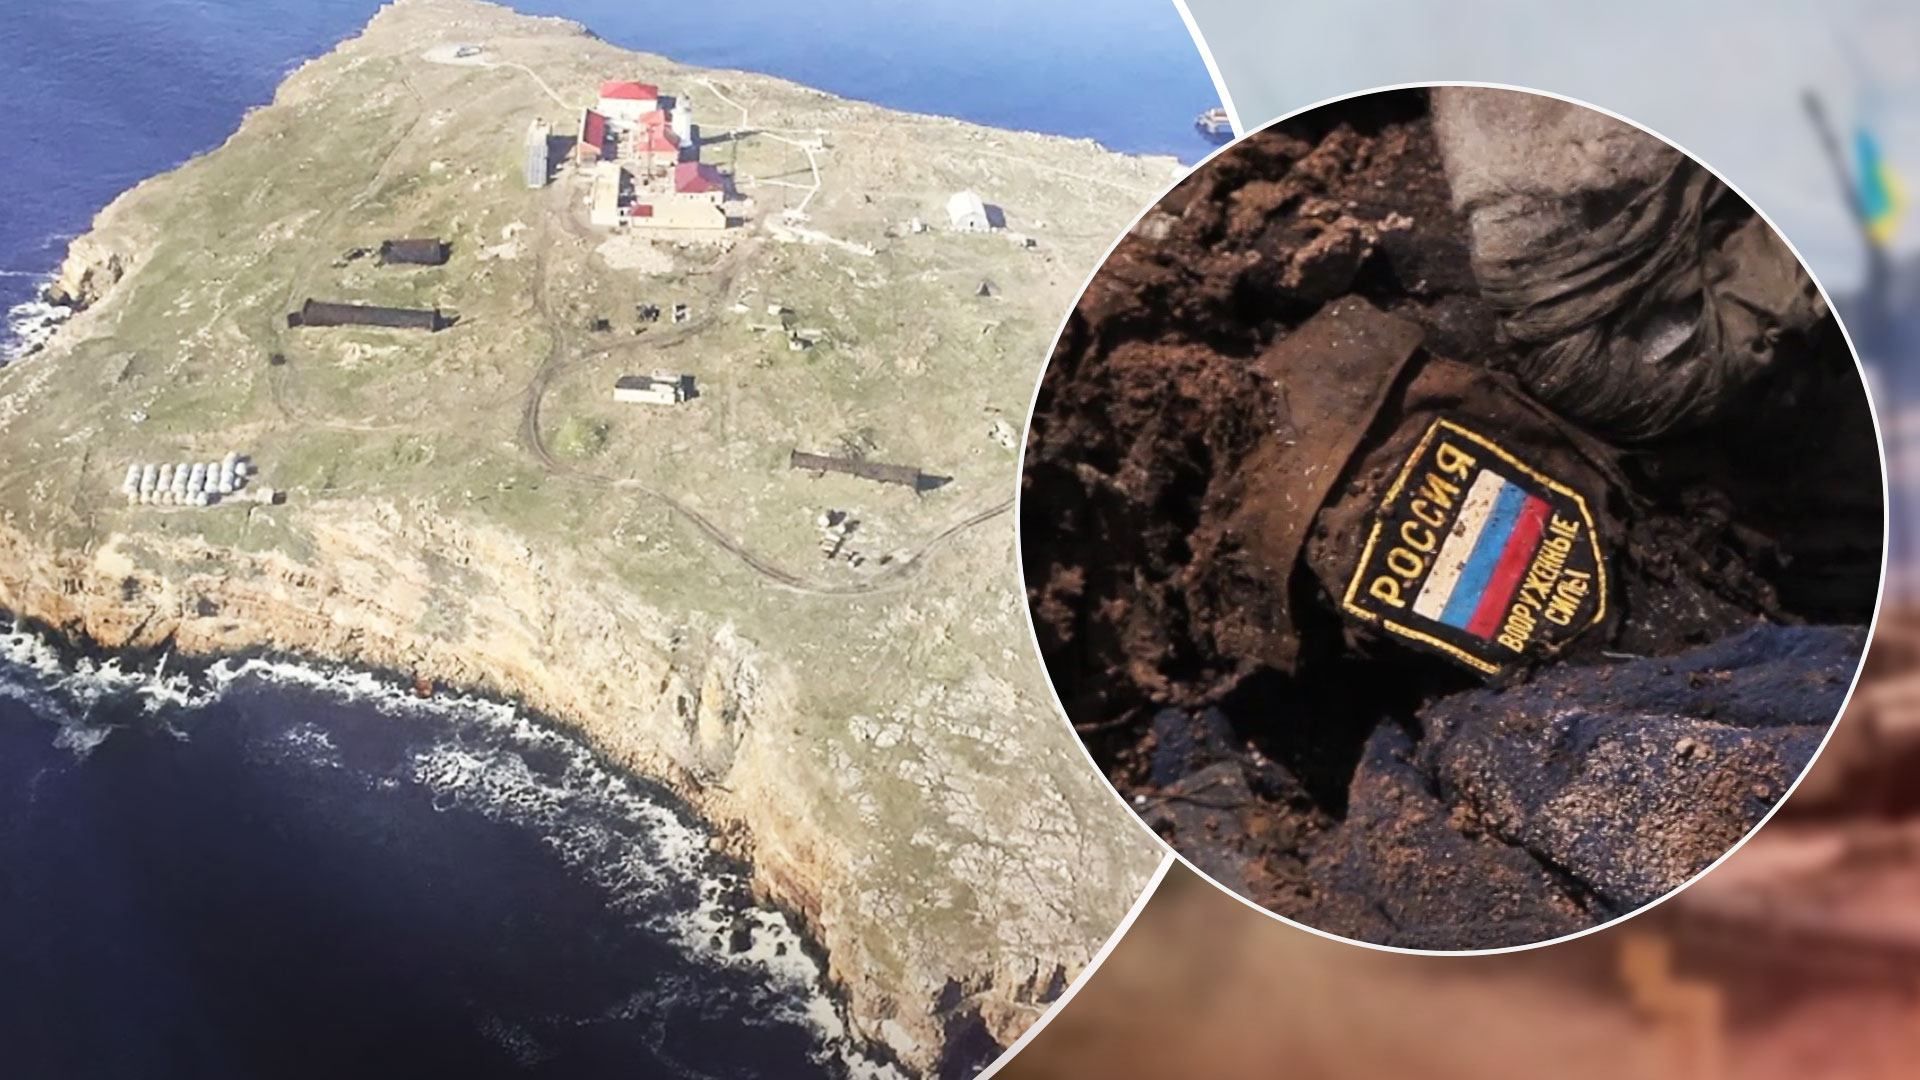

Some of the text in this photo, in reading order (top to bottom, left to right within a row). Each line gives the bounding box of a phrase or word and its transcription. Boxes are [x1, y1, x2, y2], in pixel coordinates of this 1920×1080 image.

[1370, 442, 1476, 608] РОССИЯ
[1498, 514, 1580, 653] ВООРУЖЕННЫЕ
[1545, 569, 1591, 626] СИЛЫ
